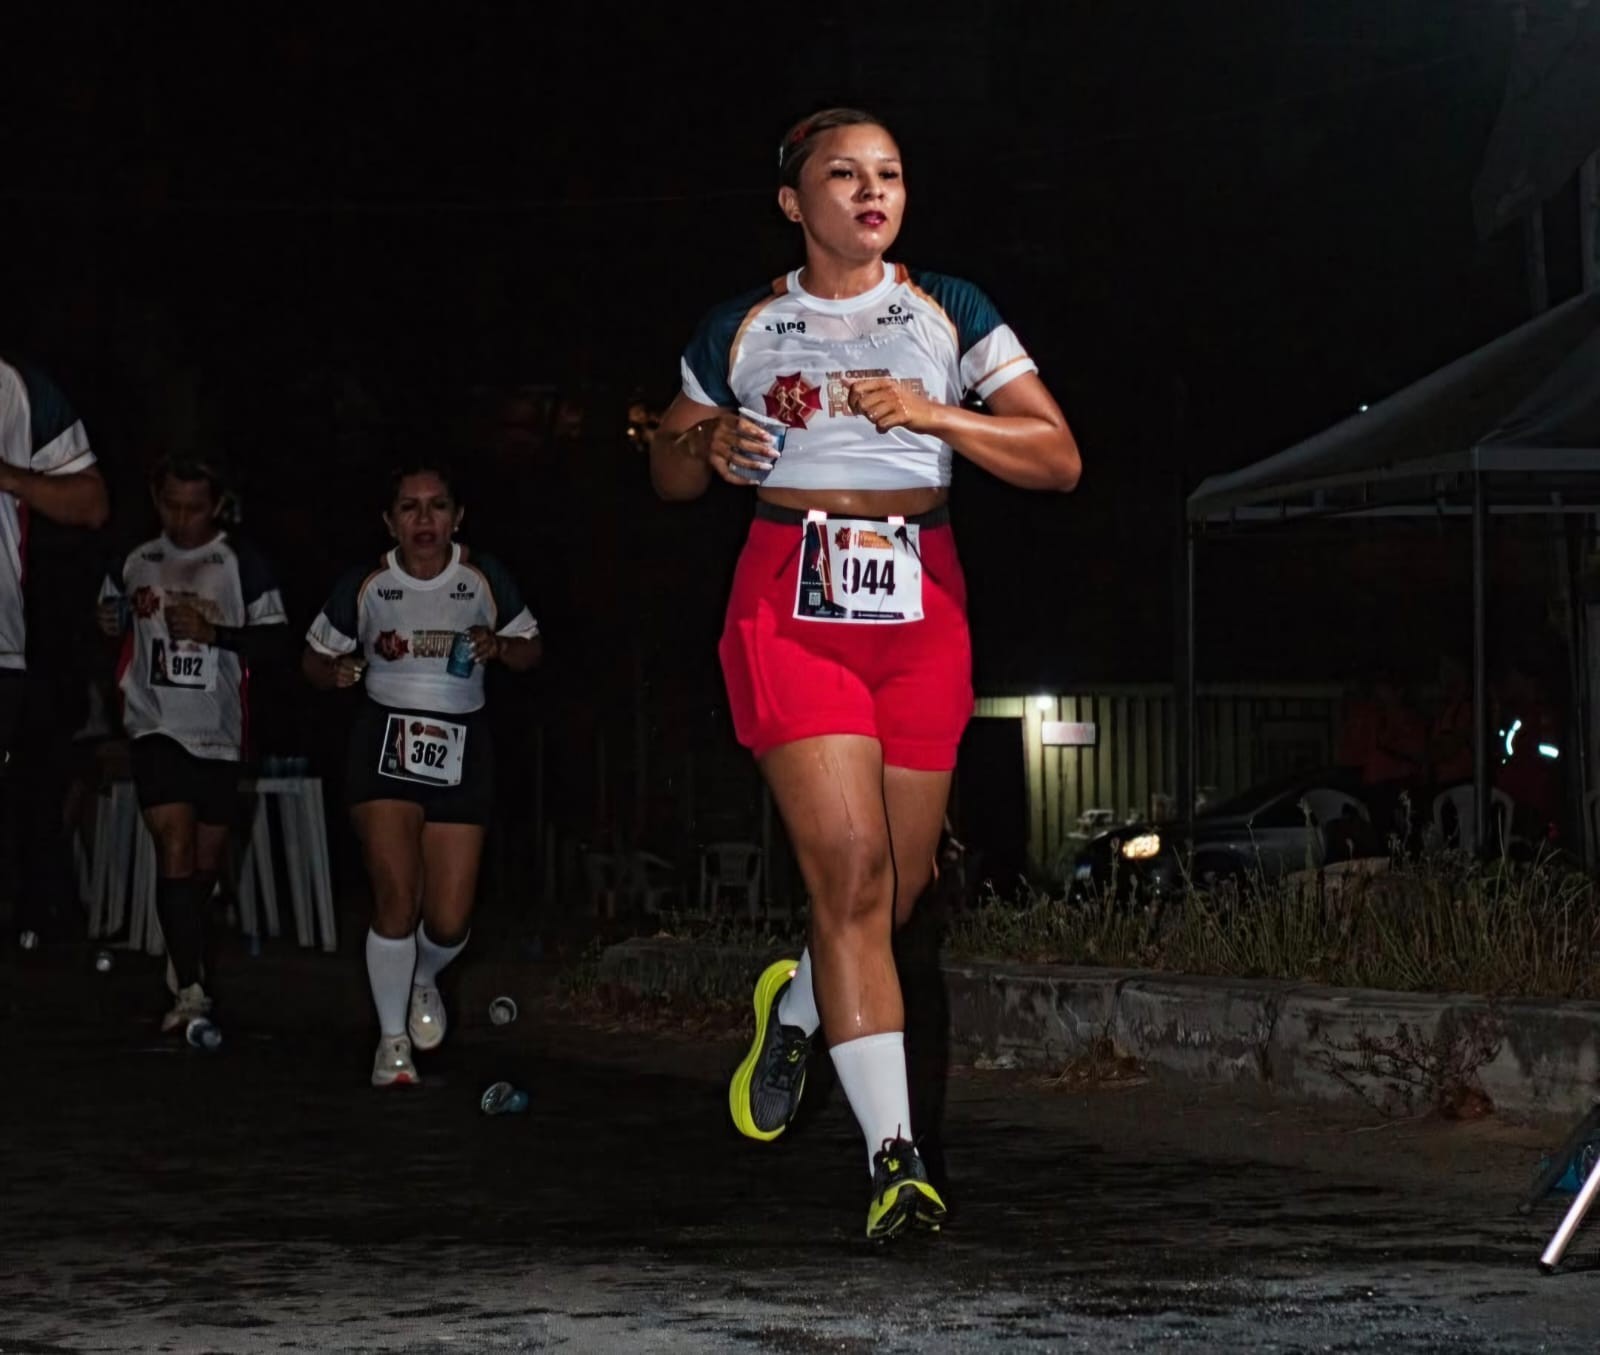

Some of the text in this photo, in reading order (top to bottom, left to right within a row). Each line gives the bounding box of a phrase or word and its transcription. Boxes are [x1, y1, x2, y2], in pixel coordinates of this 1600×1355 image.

[842, 557, 896, 596] 944
[172, 655, 203, 677] 982
[411, 740, 448, 769] 362
